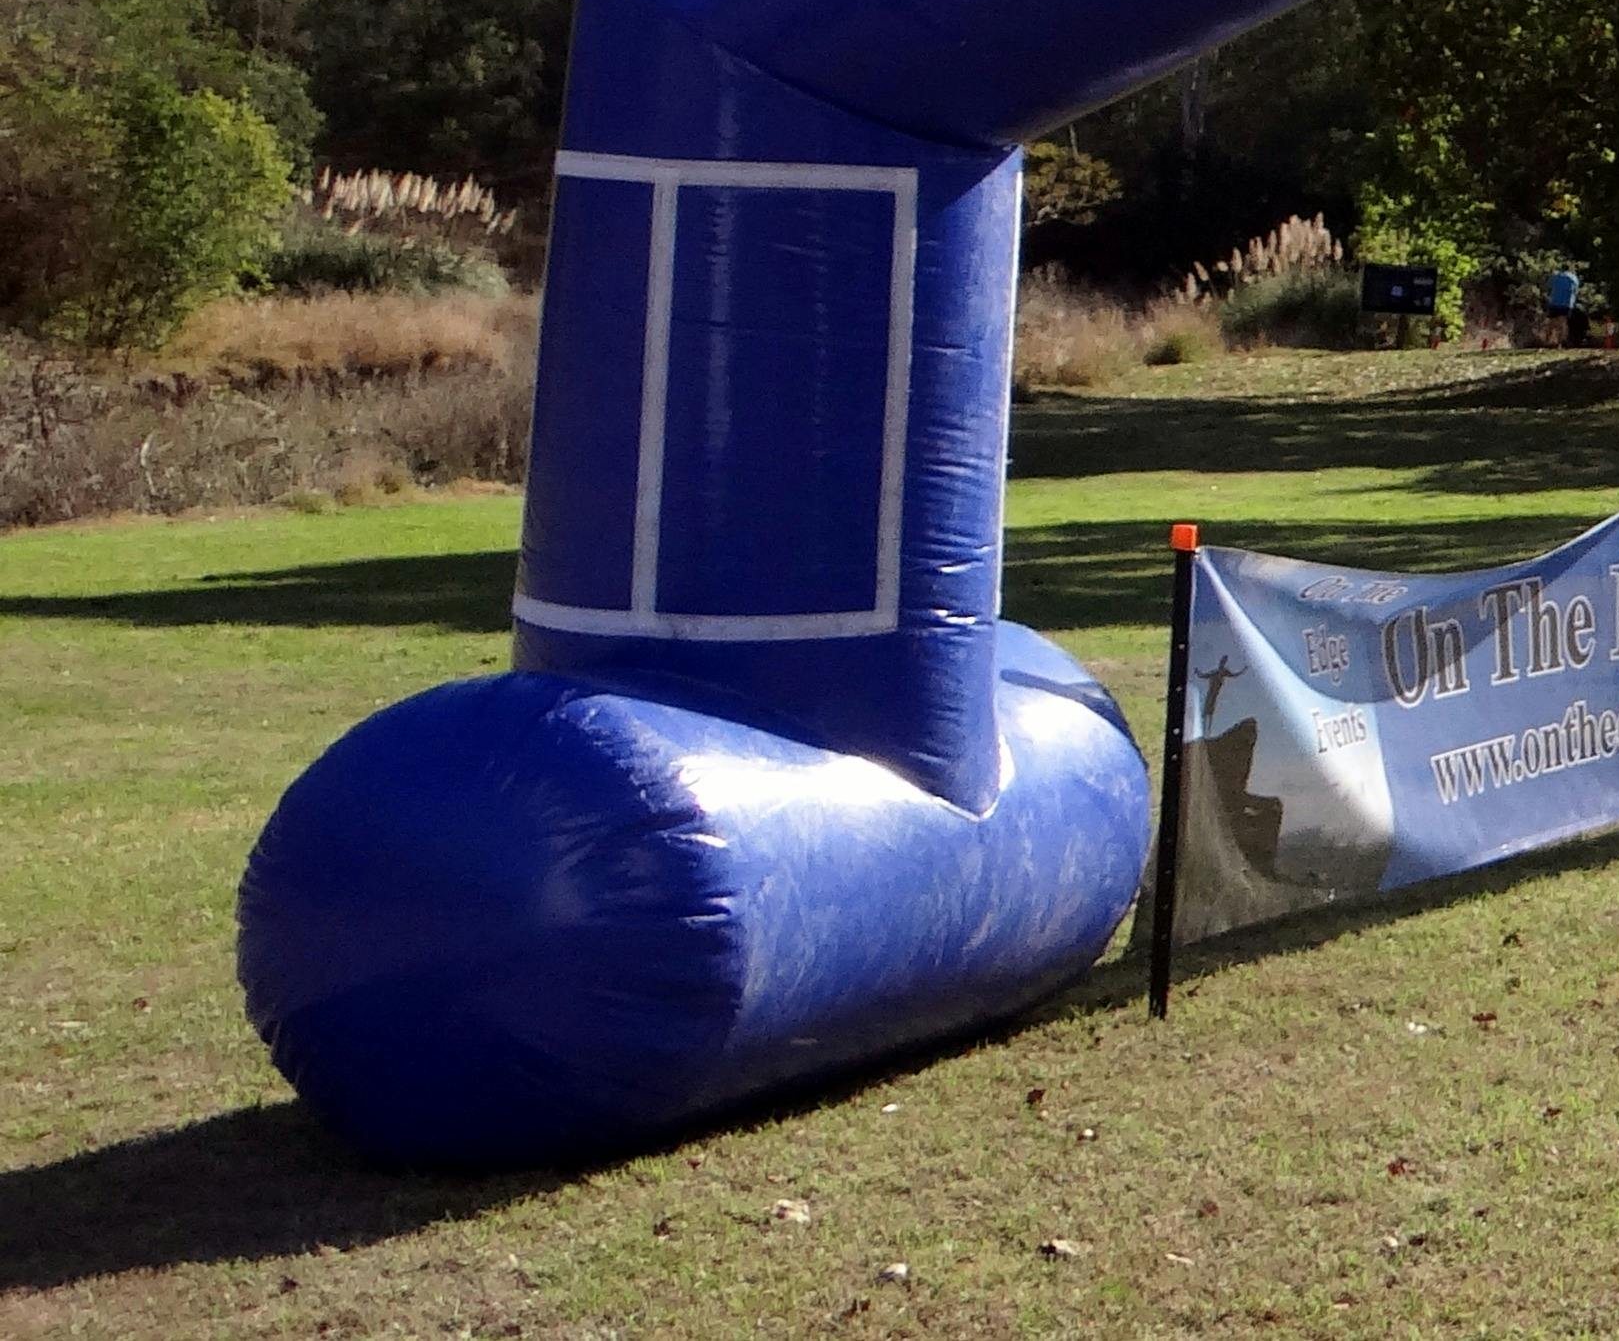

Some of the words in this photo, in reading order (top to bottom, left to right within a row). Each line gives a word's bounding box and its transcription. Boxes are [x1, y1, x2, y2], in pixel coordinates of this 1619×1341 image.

[1302, 624, 1350, 686] Edge
[1382, 605, 1470, 708] On
[1479, 575, 1596, 686] The
[1312, 706, 1368, 754] Events
